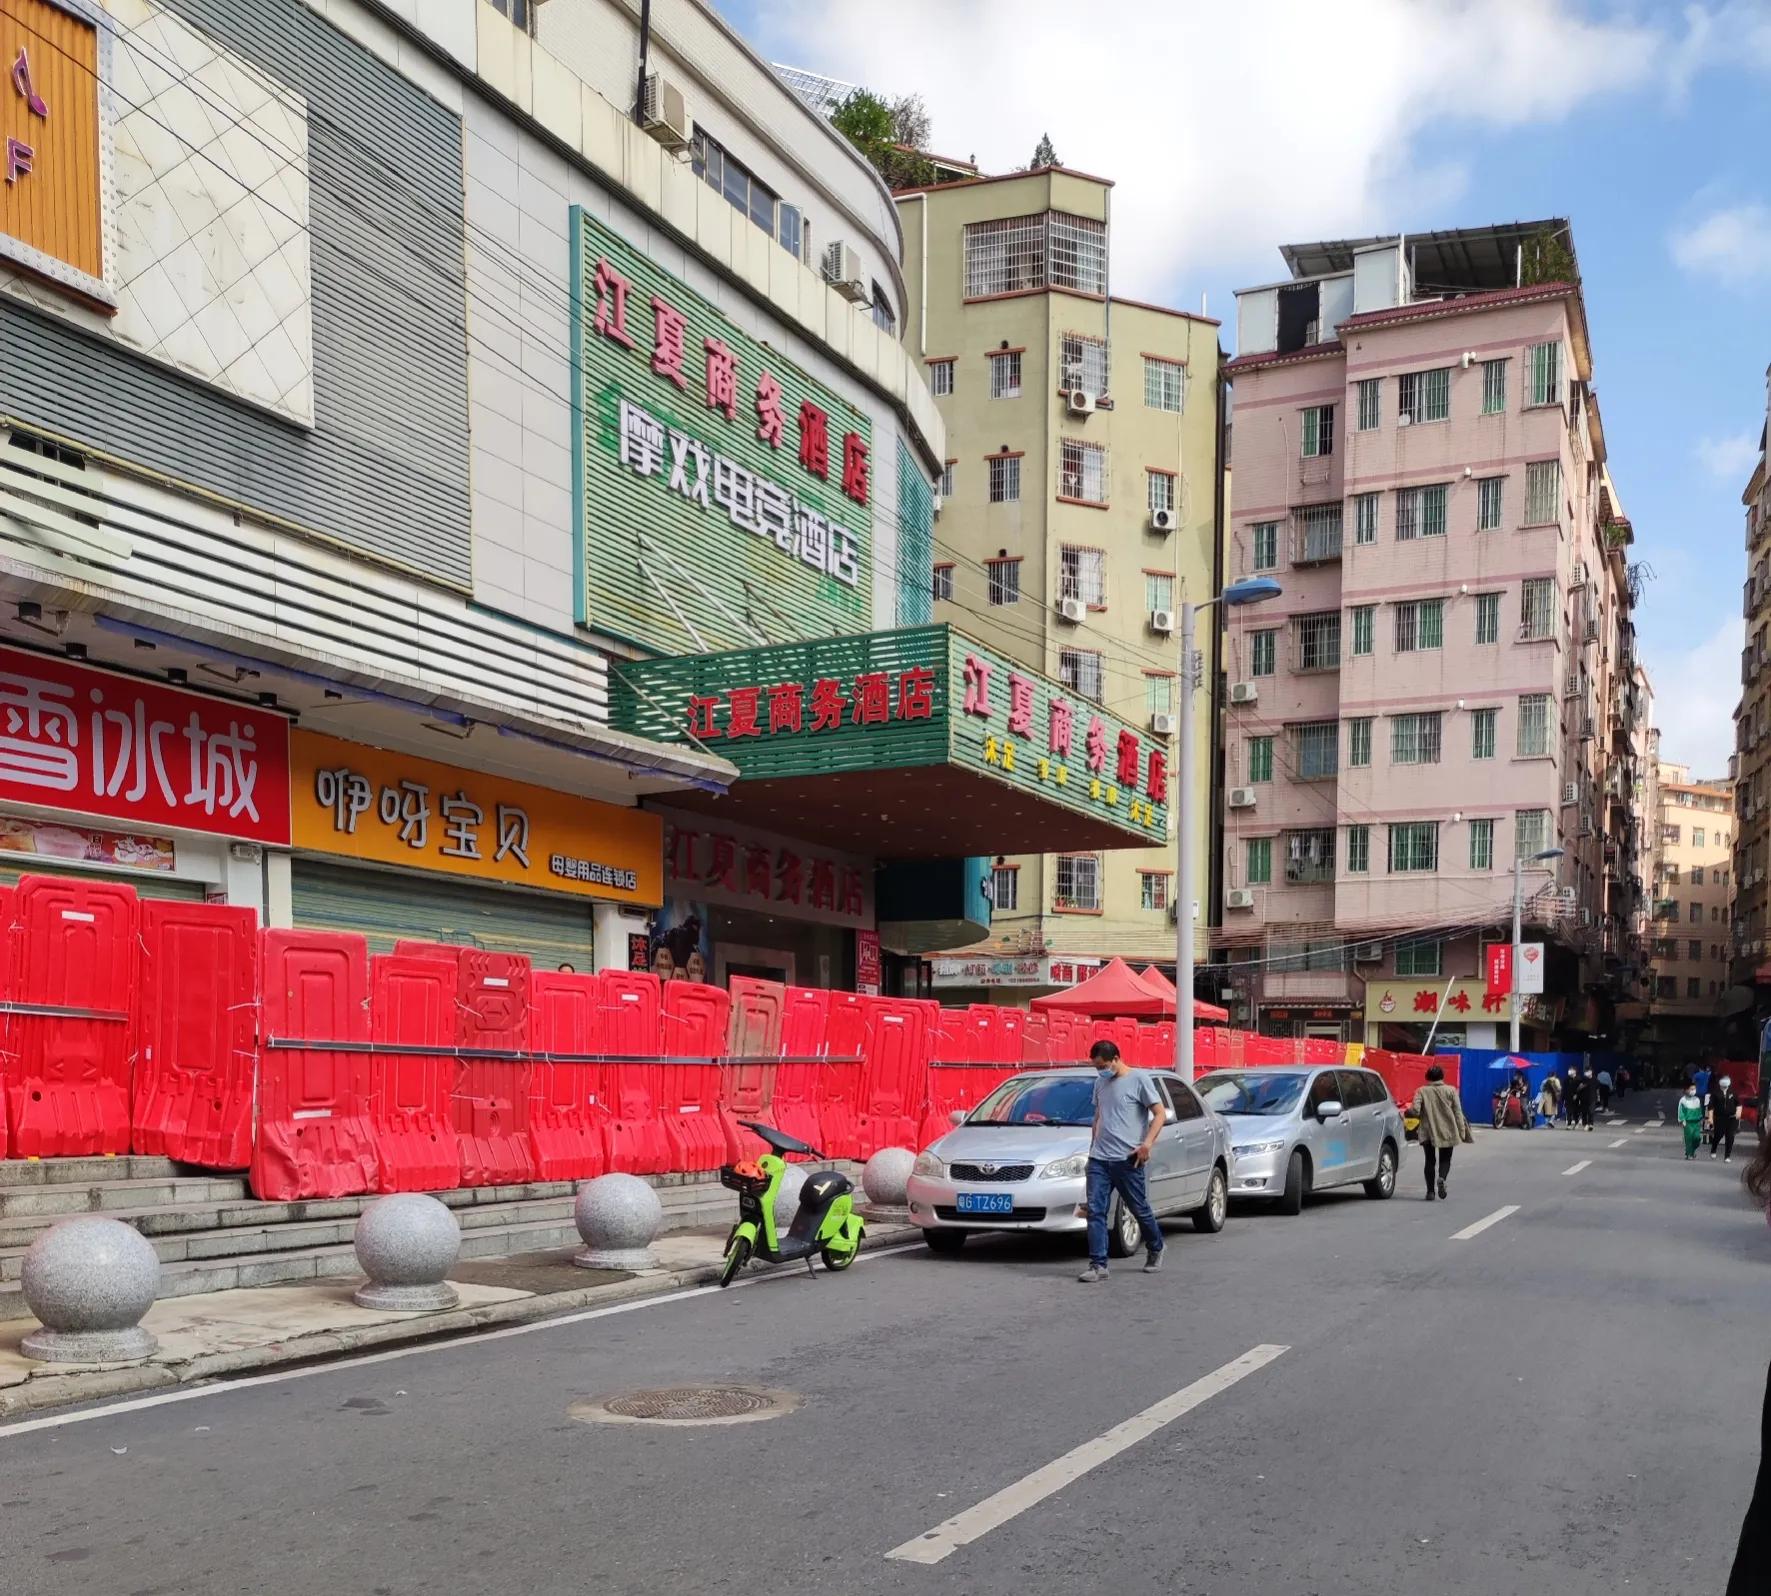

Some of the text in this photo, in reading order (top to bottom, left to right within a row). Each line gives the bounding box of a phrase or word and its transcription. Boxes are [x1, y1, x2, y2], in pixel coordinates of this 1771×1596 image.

[594, 256, 869, 507] 江夏商务酒店
[619, 399, 859, 588] 摩戏电竞酒店
[0, 671, 260, 824] 雪冰城
[686, 665, 936, 739] 江夏商务酒店
[963, 652, 1167, 804] 江夏商务酒店
[316, 767, 532, 870] 咿呀宝贝
[550, 854, 638, 890] 母婴用品连锁店
[667, 825, 864, 917] 江夏商务酒店
